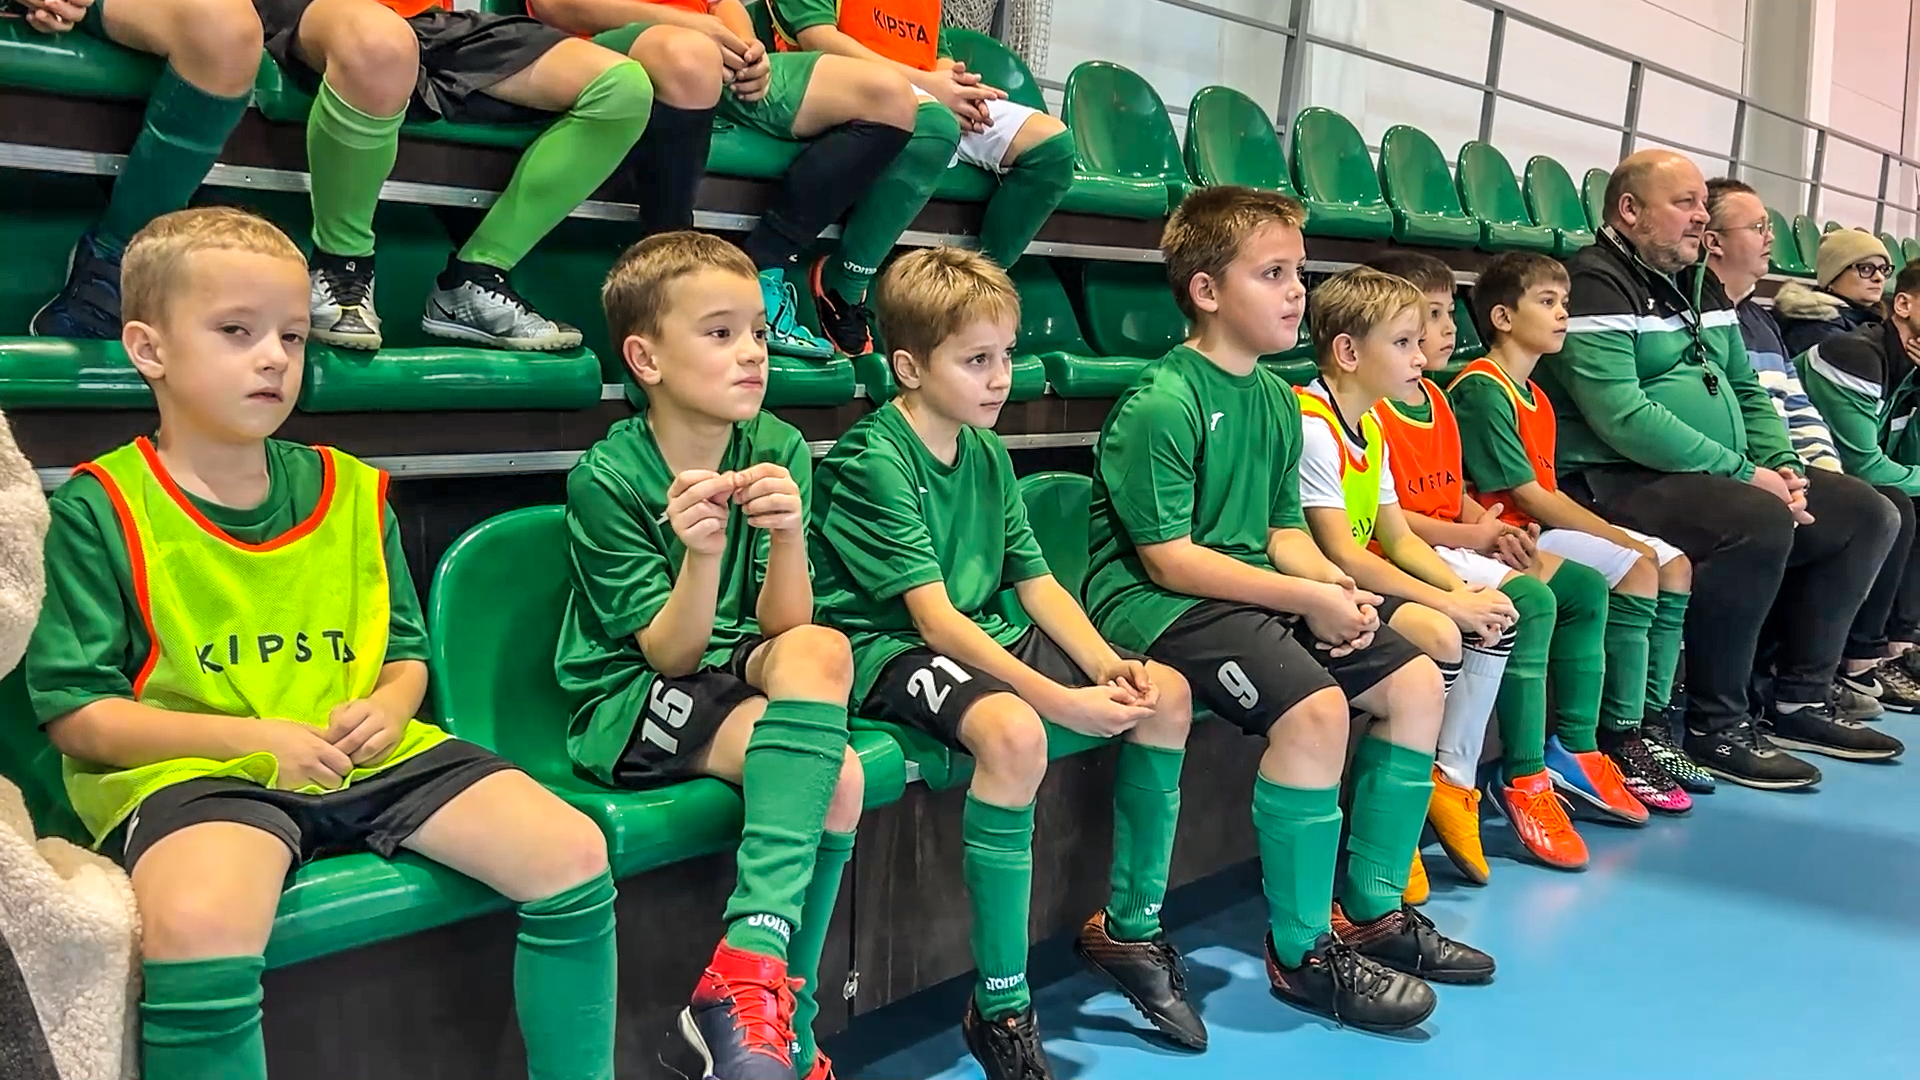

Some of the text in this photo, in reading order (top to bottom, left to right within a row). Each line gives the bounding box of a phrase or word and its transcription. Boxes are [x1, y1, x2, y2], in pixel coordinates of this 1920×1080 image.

[873, 7, 930, 45] KIPSTA
[906, 655, 974, 715] 21
[1217, 660, 1260, 710] 9
[641, 679, 694, 755] 15
